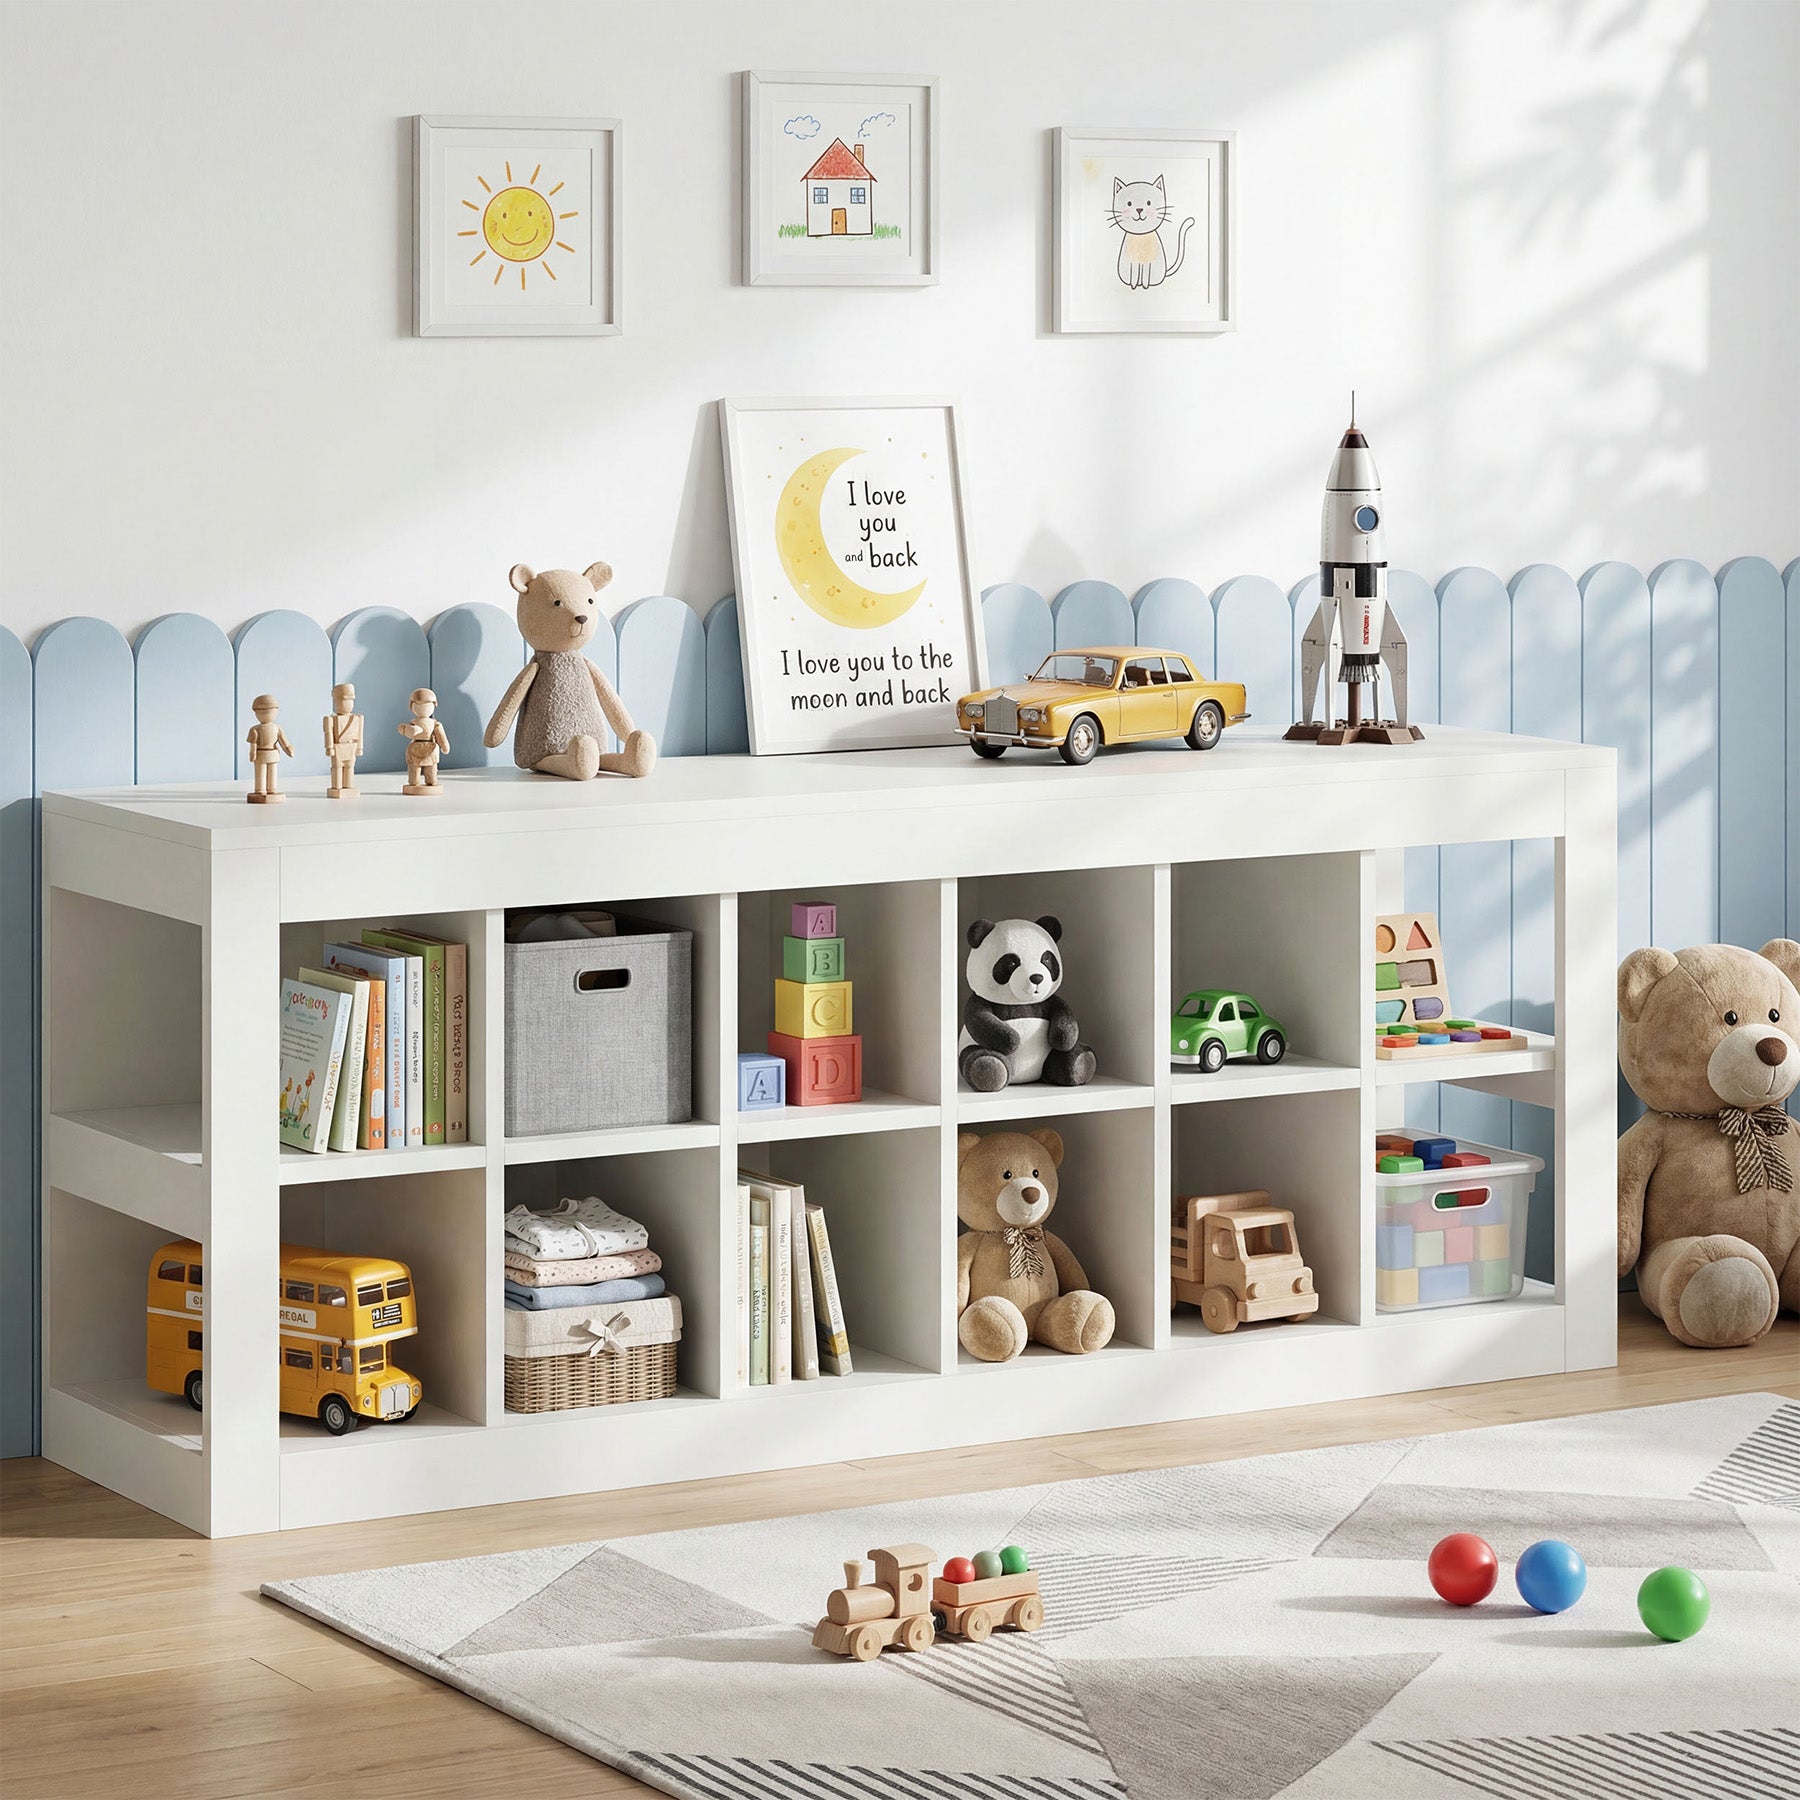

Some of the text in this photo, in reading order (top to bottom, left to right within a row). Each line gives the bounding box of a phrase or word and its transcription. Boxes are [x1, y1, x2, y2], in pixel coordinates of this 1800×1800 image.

[847, 480, 907, 507] I love
[859, 517, 897, 542] you
[844, 541, 918, 568] and back
[780, 642, 953, 682] I love you to the
[791, 677, 951, 711] moon and back
[811, 911, 830, 934] A
[811, 948, 836, 976] B
[811, 996, 841, 1027] C
[747, 1070, 776, 1103] A
[812, 1054, 848, 1091] D
